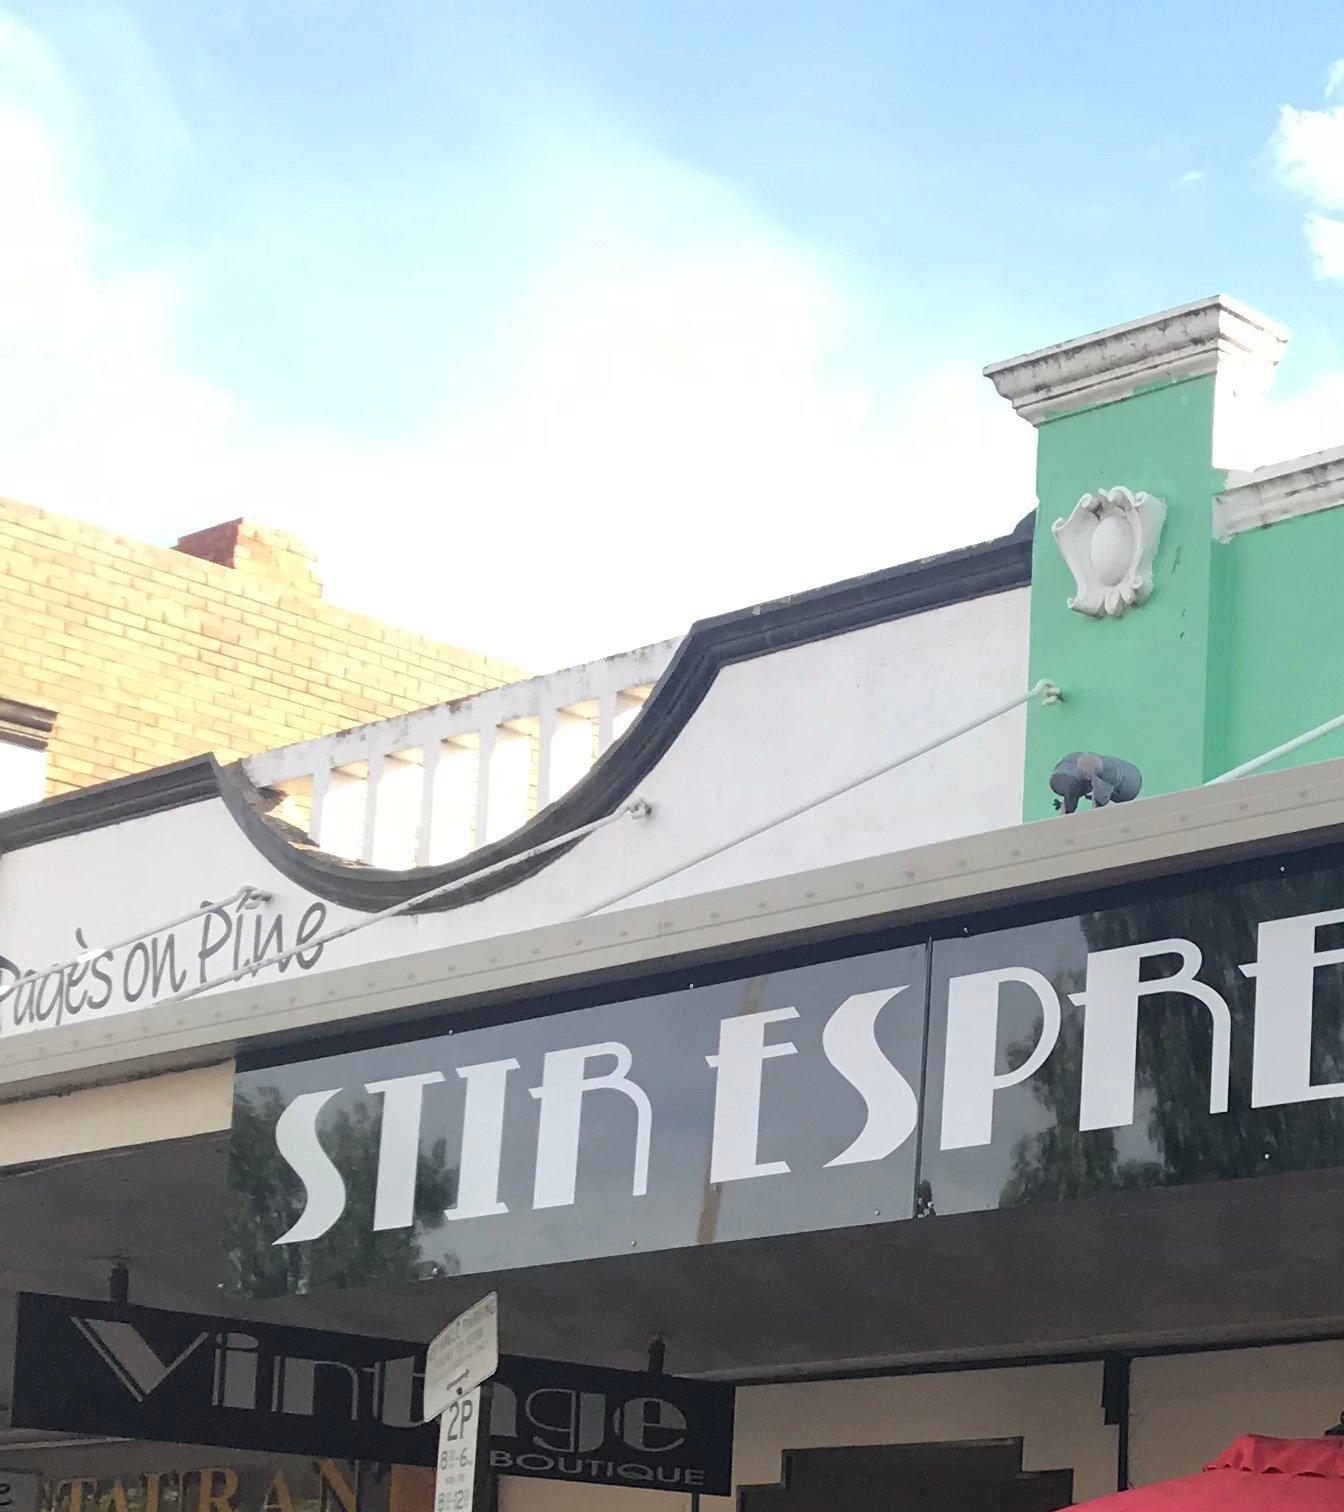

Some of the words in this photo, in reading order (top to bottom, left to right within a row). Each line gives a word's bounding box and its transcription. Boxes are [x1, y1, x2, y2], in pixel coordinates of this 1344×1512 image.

[123, 932, 187, 1003] on
[198, 892, 327, 983] Pine
[272, 1041, 652, 1246] STIR
[447, 1399, 473, 1441] 2P
[489, 1451, 704, 1485] BOUTIQUE
